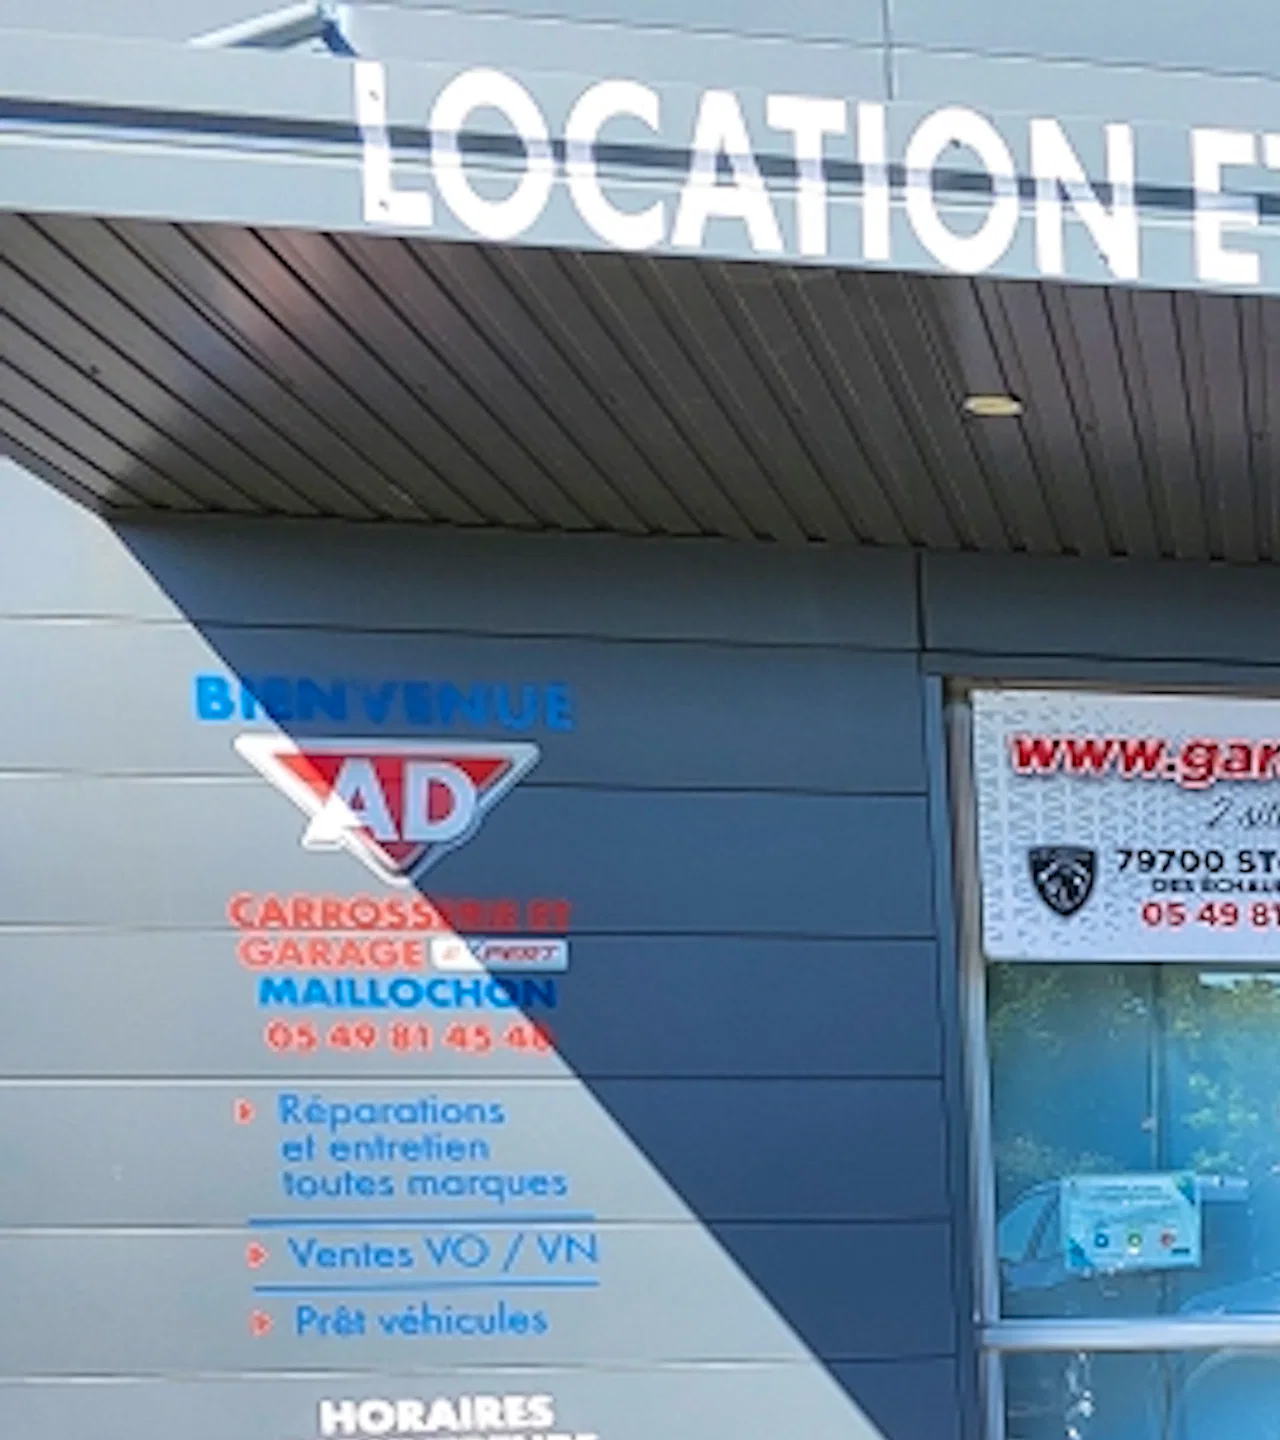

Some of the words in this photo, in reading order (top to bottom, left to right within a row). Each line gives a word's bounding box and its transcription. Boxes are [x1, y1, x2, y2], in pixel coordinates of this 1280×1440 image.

[353, 61, 1136, 280] LOCATION
[196, 675, 574, 731] BIENVENUE
[303, 756, 480, 846] AD
[1206, 796, 1233, 829] 2
[1115, 849, 1223, 874] 79700
[1142, 902, 1186, 927] 05
[1199, 903, 1239, 927] 49
[238, 939, 424, 971] GARAGE
[258, 977, 557, 1009] MAILLOCHON
[266, 1020, 317, 1053] 05
[328, 1020, 377, 1053] 49
[389, 1020, 432, 1053] 81
[443, 1021, 493, 1054] 45
[278, 1093, 505, 1131] Réparations
[281, 1136, 321, 1163] et
[330, 1135, 489, 1163] entretien
[283, 1171, 394, 1199] toutes
[408, 1171, 568, 1204] marques
[287, 1236, 413, 1269] Ventes
[424, 1233, 488, 1268] VO
[503, 1232, 524, 1272] /
[538, 1232, 600, 1266] VN
[294, 1302, 366, 1336] Prêt
[380, 1301, 549, 1336] véhicules
[319, 1395, 554, 1436] HORAIRES
